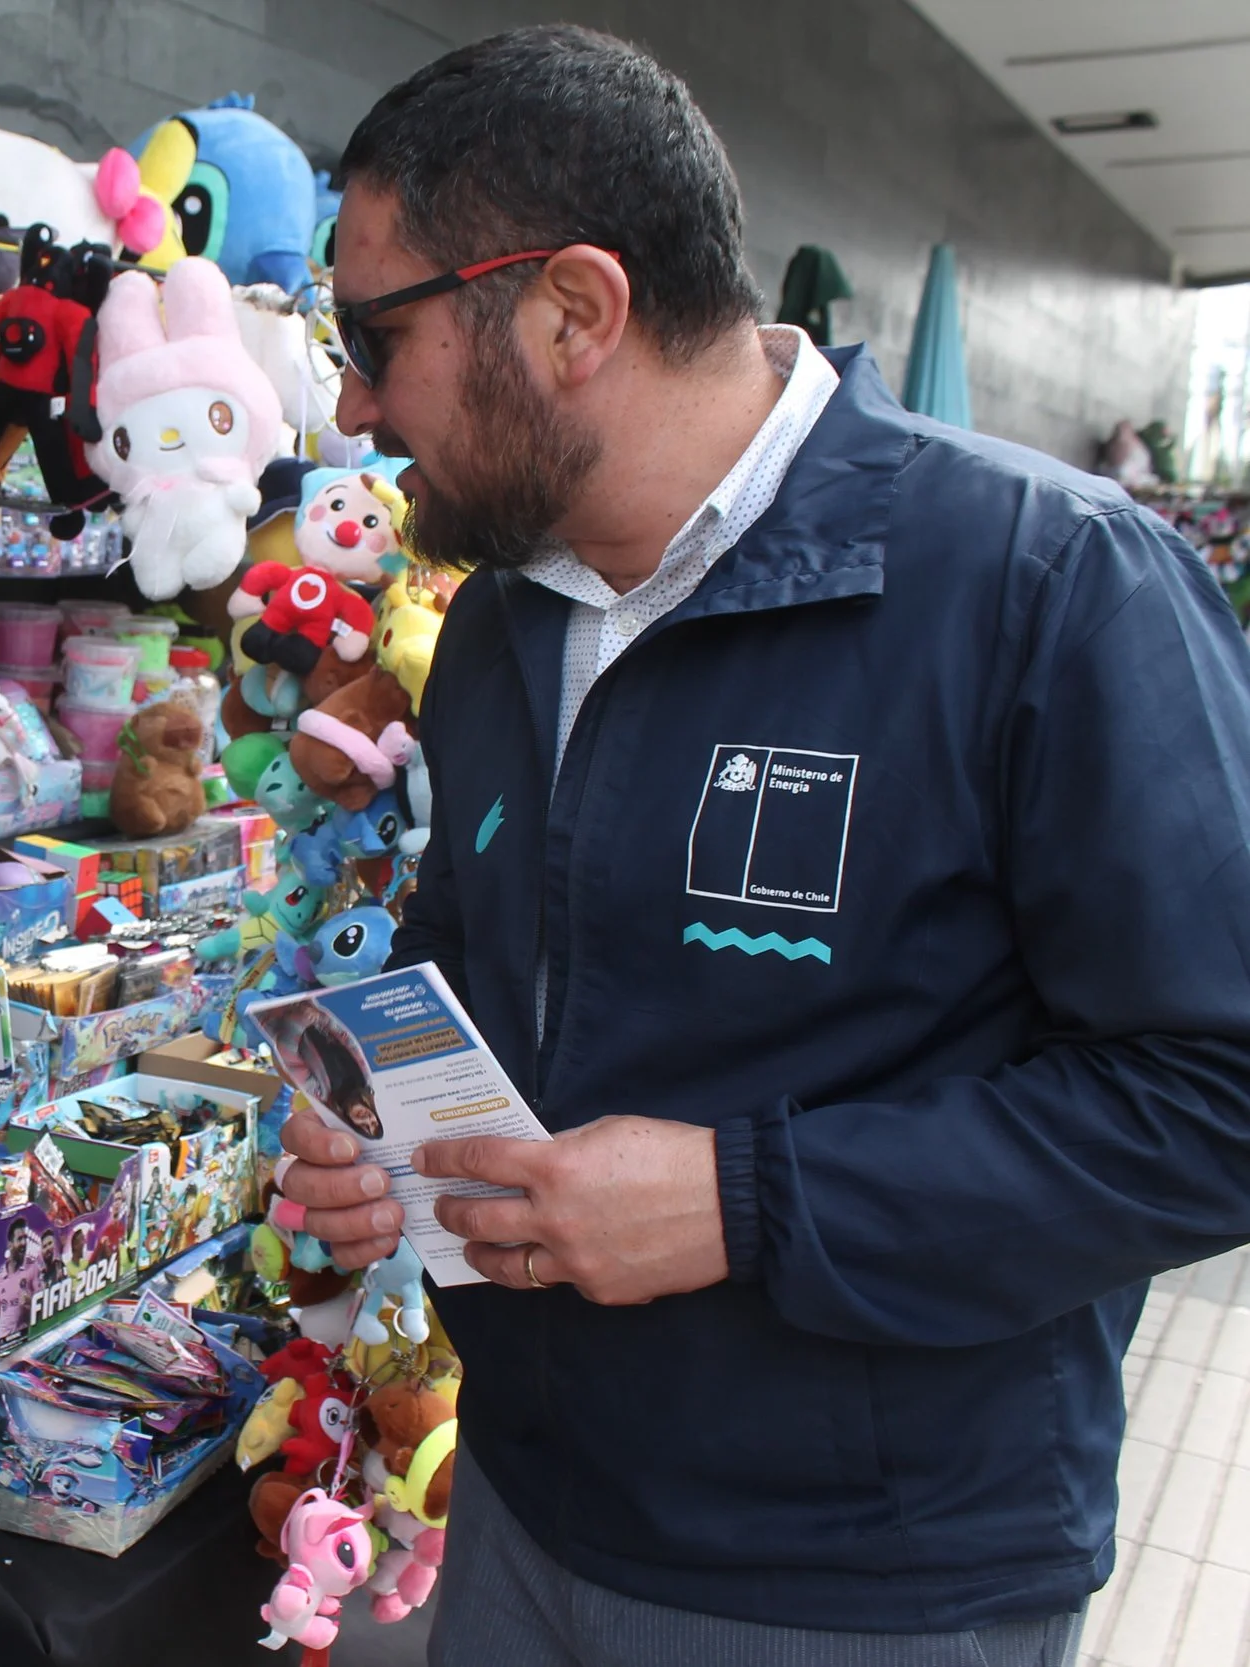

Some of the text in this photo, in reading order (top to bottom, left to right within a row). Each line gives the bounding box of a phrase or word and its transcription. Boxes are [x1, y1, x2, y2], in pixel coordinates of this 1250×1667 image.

[770, 763, 843, 783] Ministerio de
[768, 777, 810, 794] Energía
[750, 884, 831, 903] Gobierno de Chile
[31, 1252, 117, 1326] FIFA 2024
